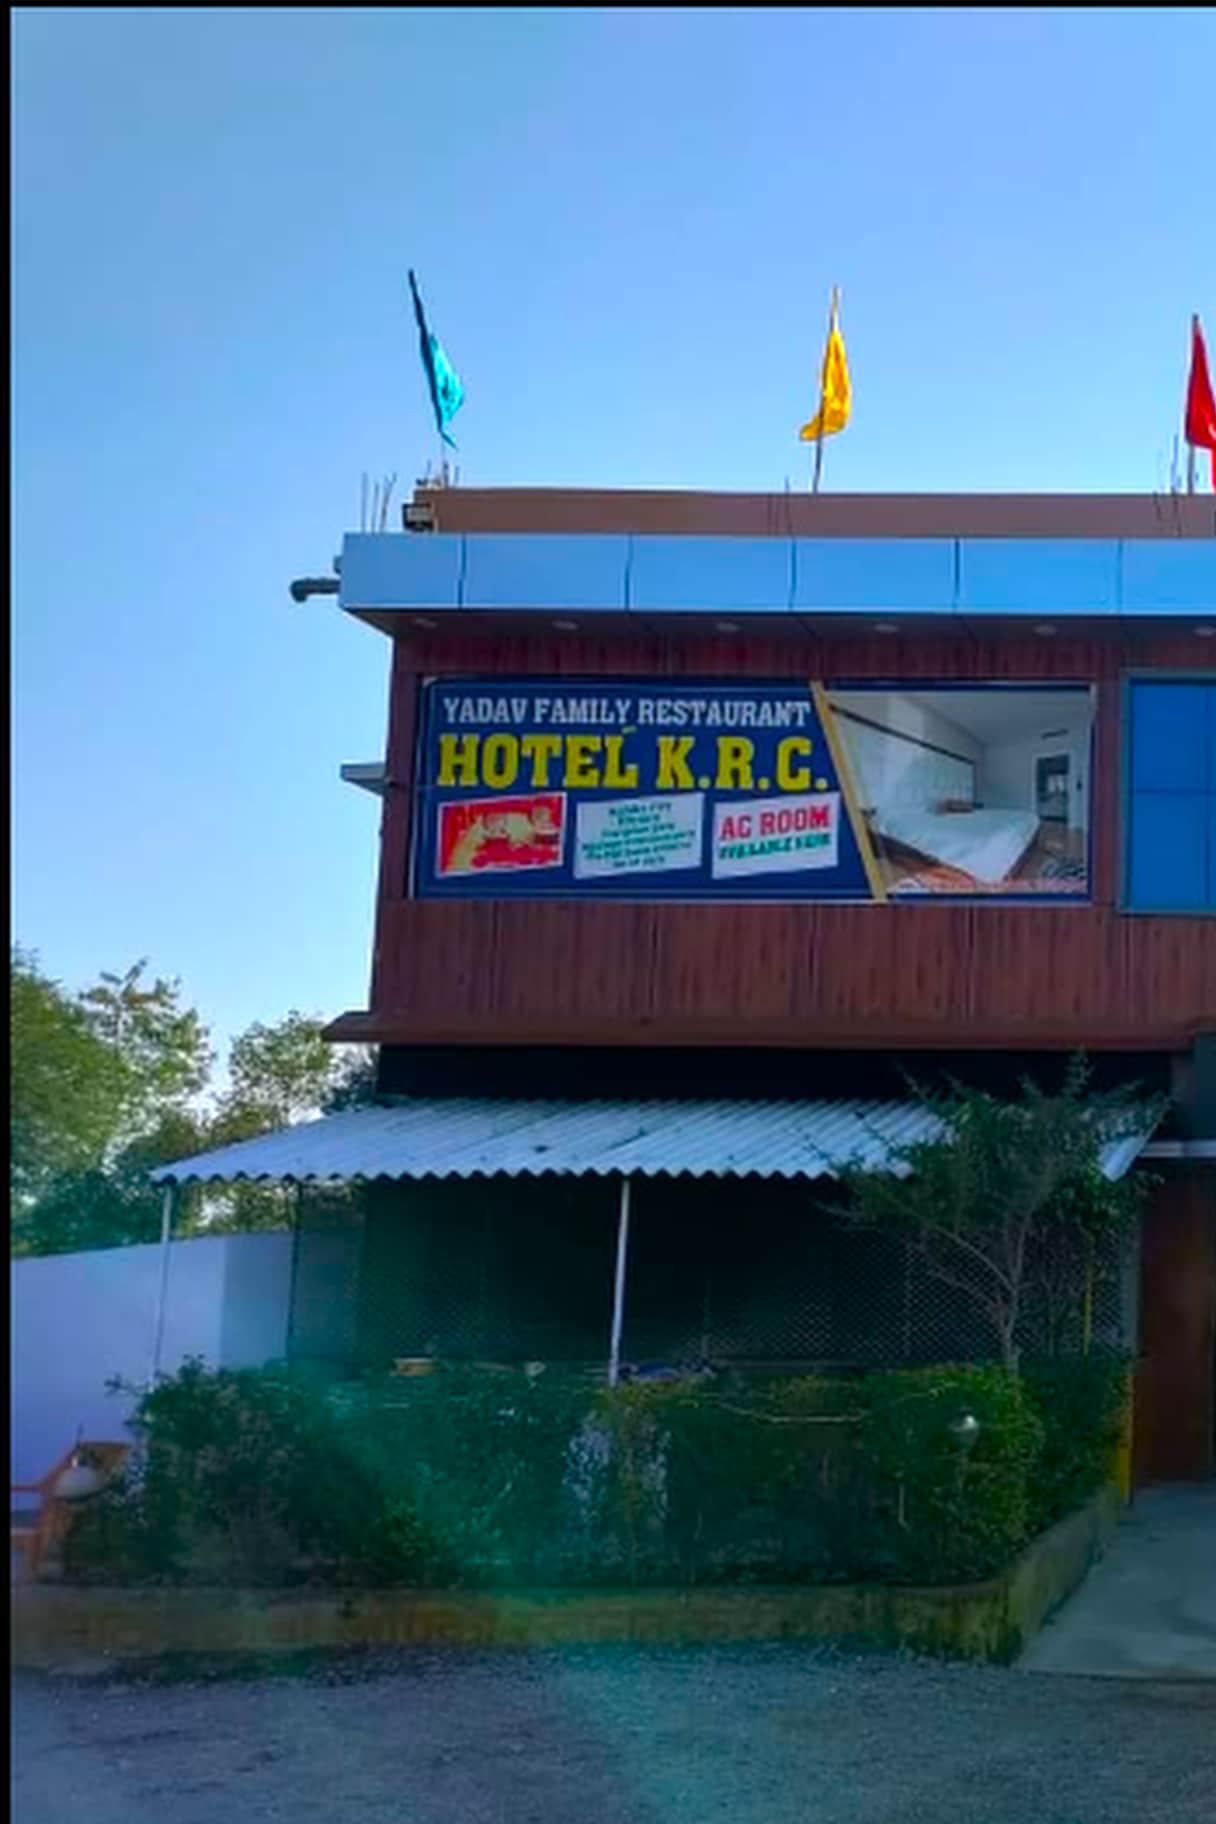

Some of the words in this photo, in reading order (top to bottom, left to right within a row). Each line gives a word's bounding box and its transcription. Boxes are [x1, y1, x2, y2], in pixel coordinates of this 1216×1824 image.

[443, 697, 529, 724] YADAV
[534, 698, 633, 725] FAMILY
[637, 700, 811, 727] RESTAURANT
[436, 732, 639, 790] HOTEL
[656, 735, 830, 791] K.R.C.
[720, 815, 753, 840] AC
[759, 804, 830, 834] ROOM
